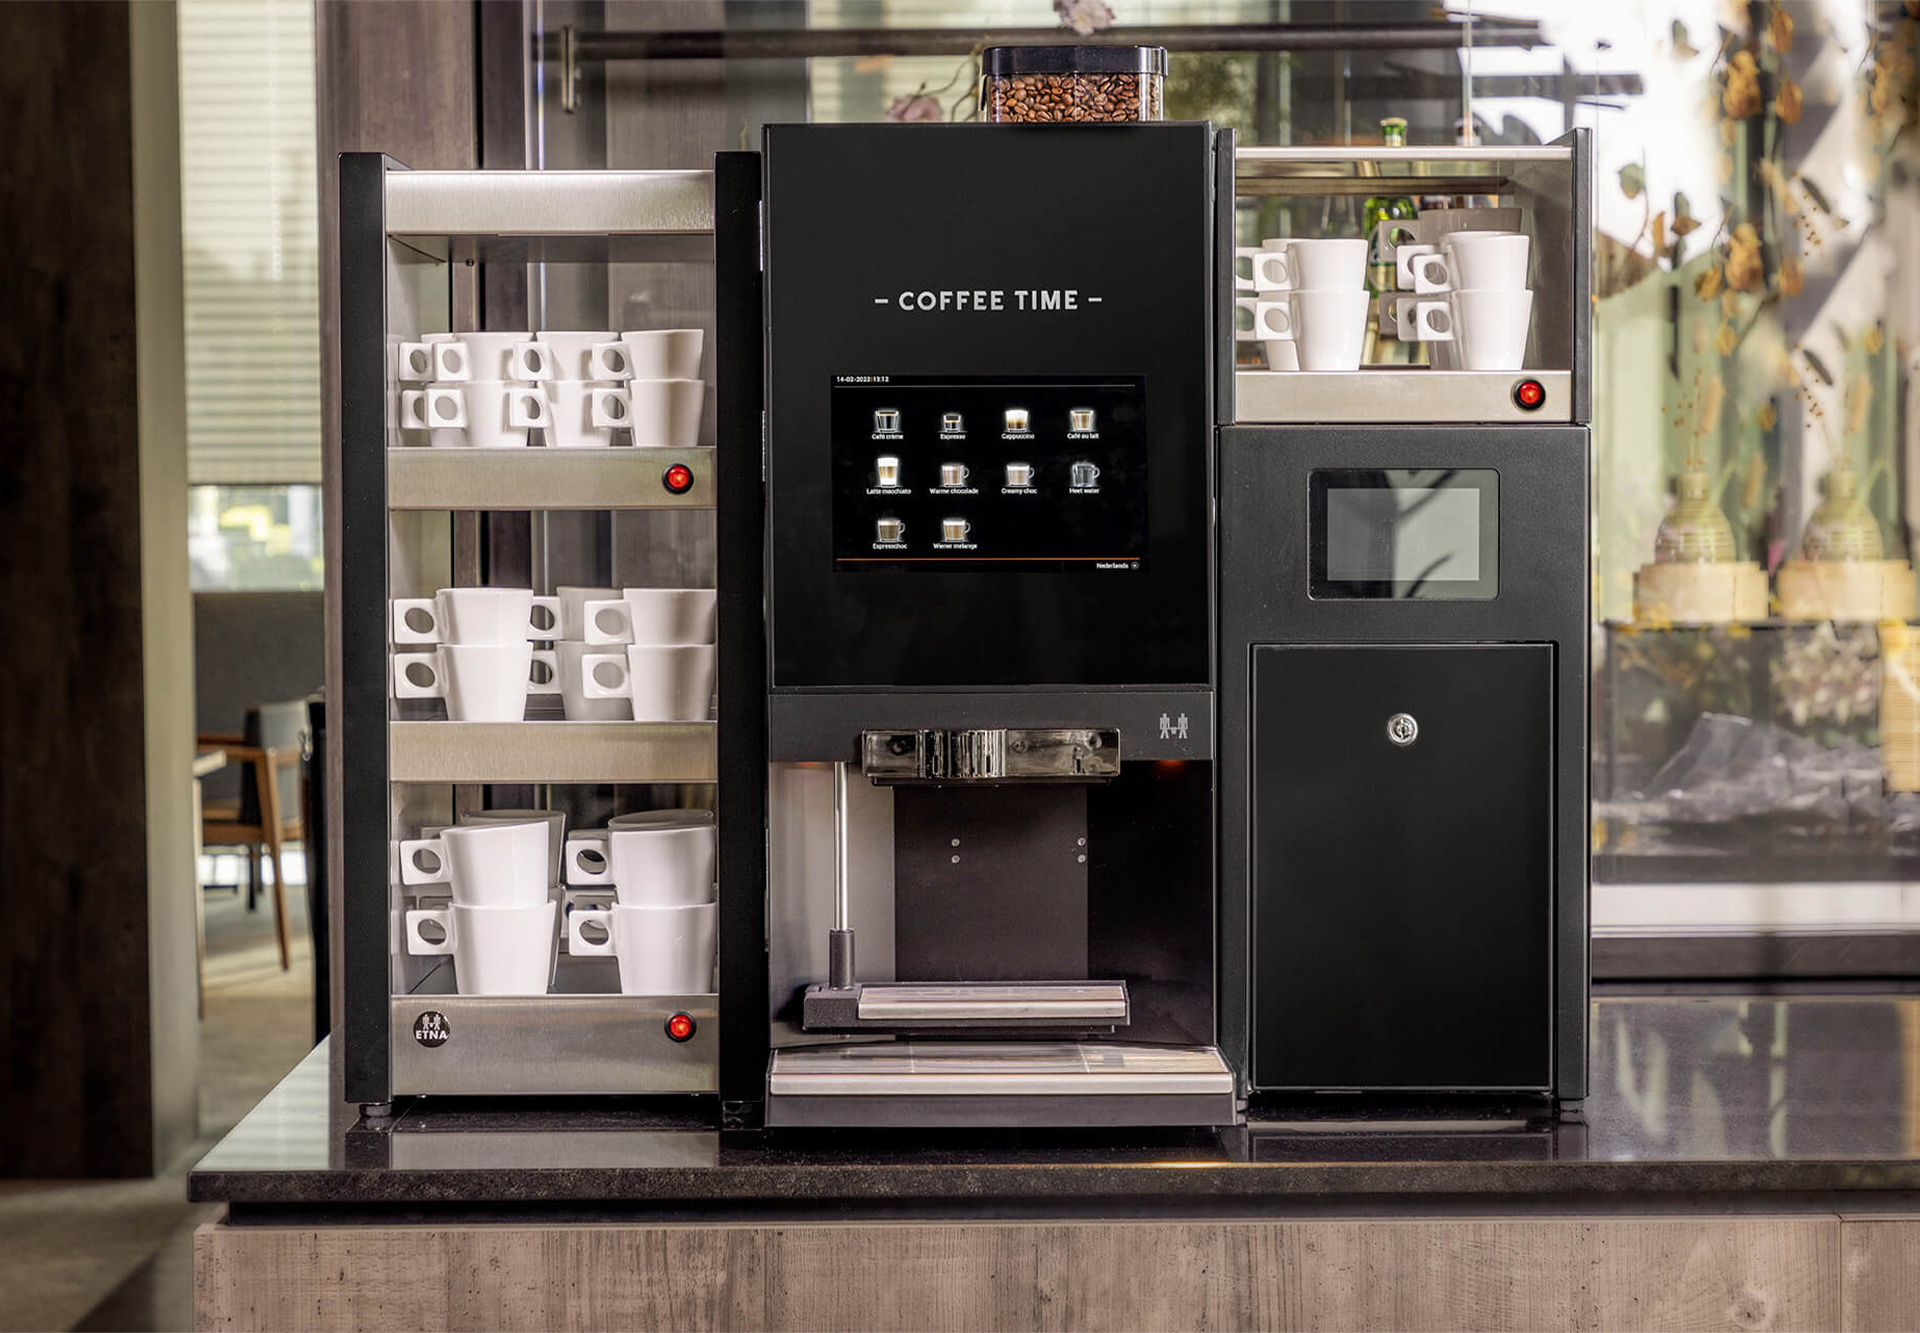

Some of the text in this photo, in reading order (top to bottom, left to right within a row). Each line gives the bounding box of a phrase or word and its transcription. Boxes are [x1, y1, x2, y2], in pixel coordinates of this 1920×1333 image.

[898, 290, 1078, 310] COFFEE TIME
[415, 1030, 448, 1040] ETNA
